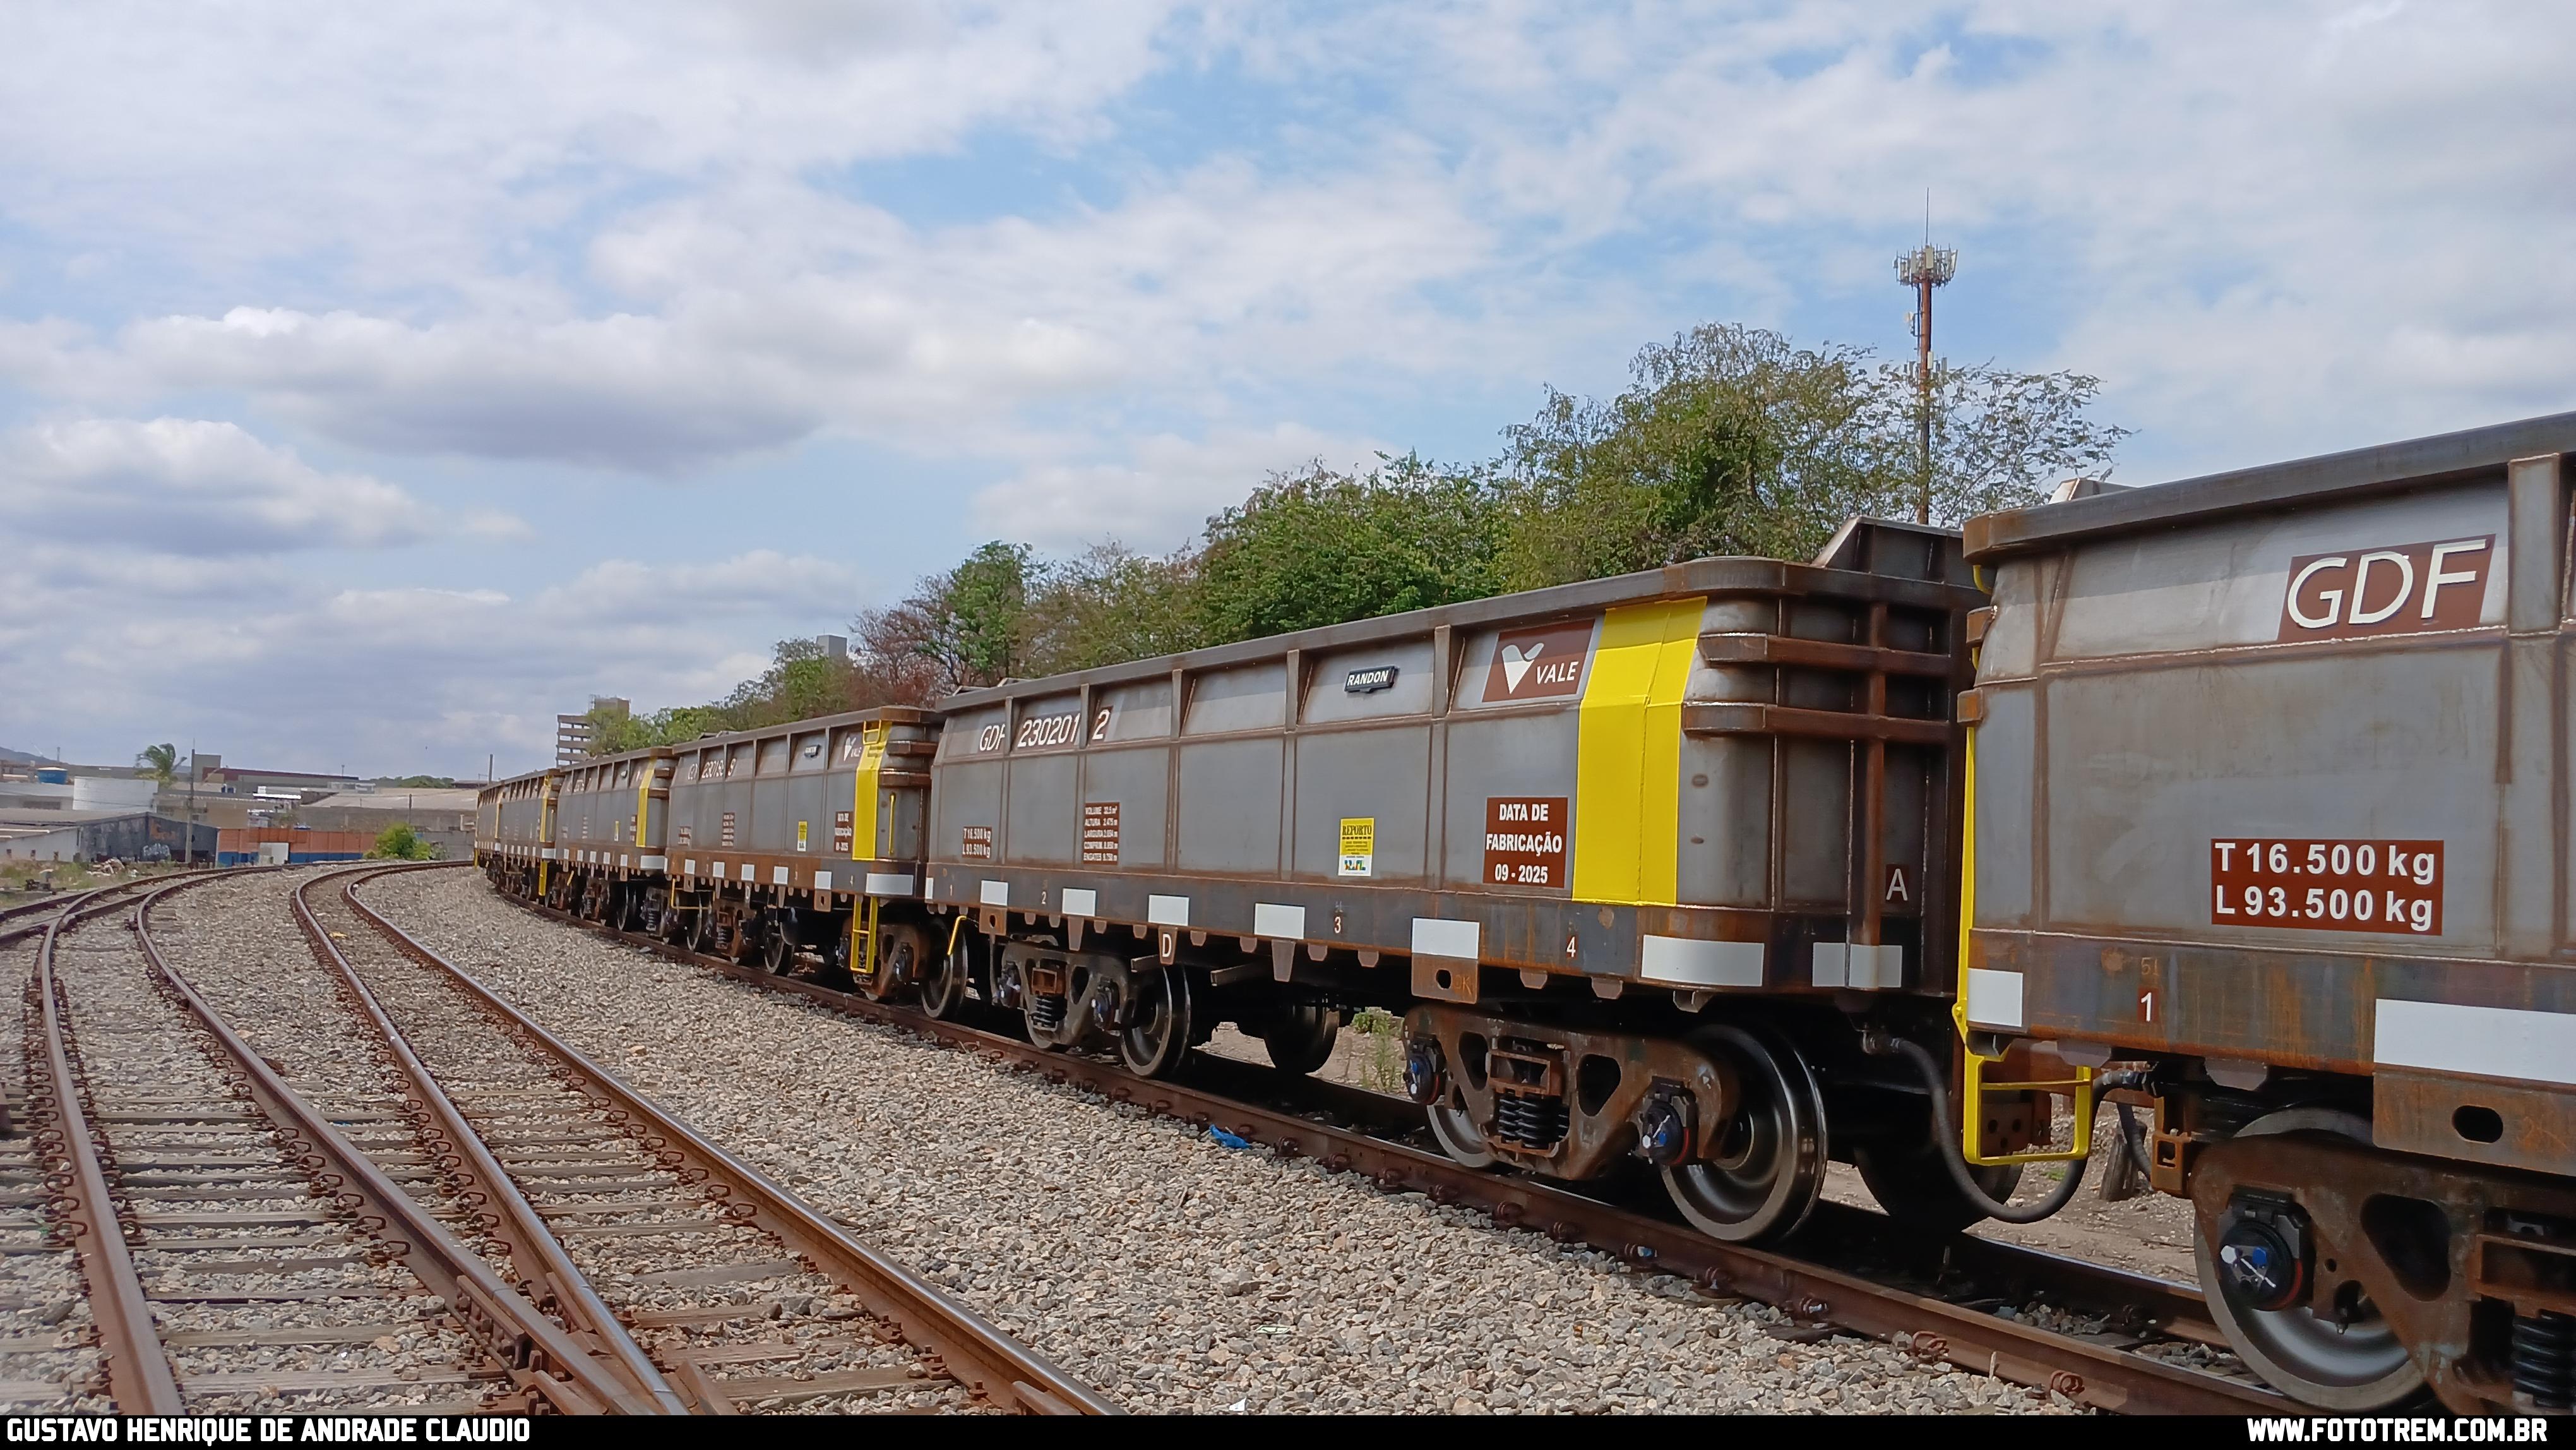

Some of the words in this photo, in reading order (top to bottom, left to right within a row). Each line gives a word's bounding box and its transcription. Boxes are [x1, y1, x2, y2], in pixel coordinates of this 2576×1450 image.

[2287, 539, 2487, 628] GDF
[1347, 670, 1389, 686] RANDON
[1537, 661, 1579, 685] VALE
[1499, 803, 1529, 821] DATA
[1531, 803, 1549, 821] DE
[1342, 824, 1372, 836] REPORTO
[1486, 830, 1563, 857] FABRICAÇÃO
[1494, 863, 1509, 881] 09
[1518, 865, 1548, 884] 2025
[2214, 842, 2236, 872] T
[2246, 843, 2376, 876] 16.500
[2387, 845, 2435, 885] kg
[1886, 868, 1908, 901] A
[1041, 891, 1047, 905] 2
[2216, 885, 2236, 914] L
[2244, 886, 2373, 921] 93.500
[2385, 890, 2433, 932] kg
[1334, 916, 1342, 934] 3
[1162, 933, 1172, 957] D
[1566, 935, 1577, 958] 4
[2140, 992, 2152, 1022] 1
